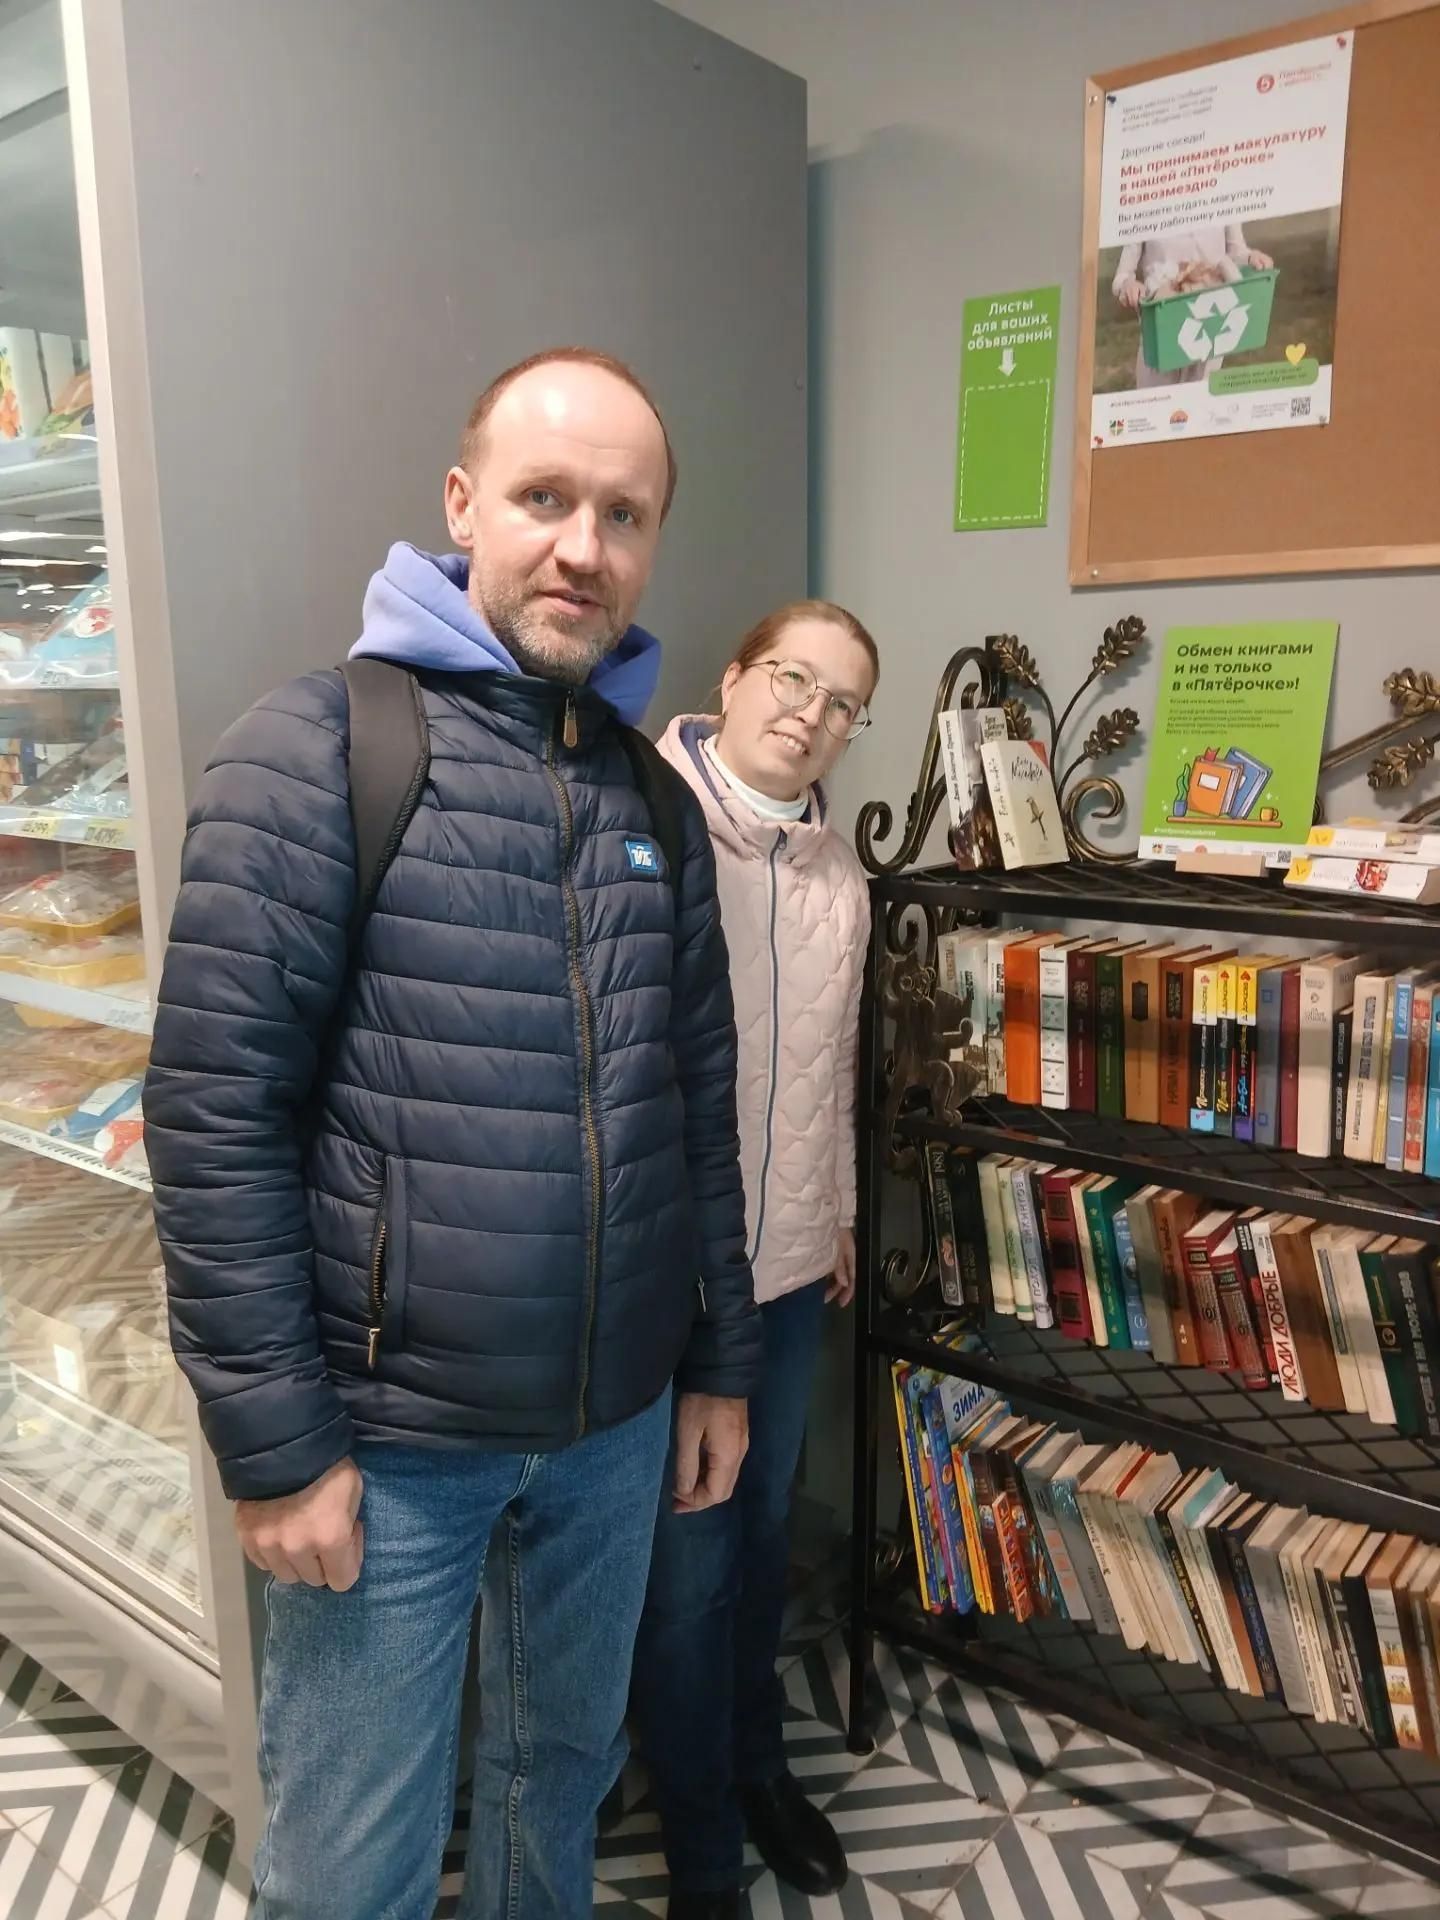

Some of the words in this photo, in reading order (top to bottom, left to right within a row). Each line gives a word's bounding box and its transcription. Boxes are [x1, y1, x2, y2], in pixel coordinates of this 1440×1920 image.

[1120, 165, 1143, 179] Мы
[1146, 145, 1230, 173] принимаем
[1233, 125, 1327, 152] макулатуру
[1121, 140, 1164, 160] Дорогие
[1165, 131, 1206, 148] соседи!
[1119, 183, 1128, 193] в
[1131, 170, 1177, 189] нашей
[1180, 152, 1275, 178] «Пятёрочке»
[1118, 212, 1132, 224] Вы
[1133, 207, 1172, 220] можете
[1174, 199, 1209, 214] отдать
[1210, 186, 1275, 206] макулатуру
[1119, 178, 1218, 207] безвозмездно
[1118, 223, 1159, 237] любому
[1160, 210, 1214, 232] работнику
[1216, 202, 1267, 217] магазина
[971, 321, 998, 337] для
[1001, 313, 1049, 331] ваших
[988, 299, 1033, 317] Листы
[967, 326, 1053, 352] объявлений
[1177, 643, 1234, 658] Обмен
[1237, 642, 1314, 657] книгами
[1172, 681, 1181, 692] в
[1185, 676, 1301, 694] «Пятёрочке»!
[1173, 662, 1186, 675] и
[1189, 662, 1209, 675] не
[1213, 661, 1273, 675] только
[1014, 1180, 1034, 1244] ВИКИНГОВ
[1029, 1255, 1042, 1297] ПОХОД
[1261, 1270, 1289, 1339] ДОБРЫЕ
[1277, 1340, 1301, 1395] ЛЮДИ
[951, 1384, 985, 1424] ЗИМА
